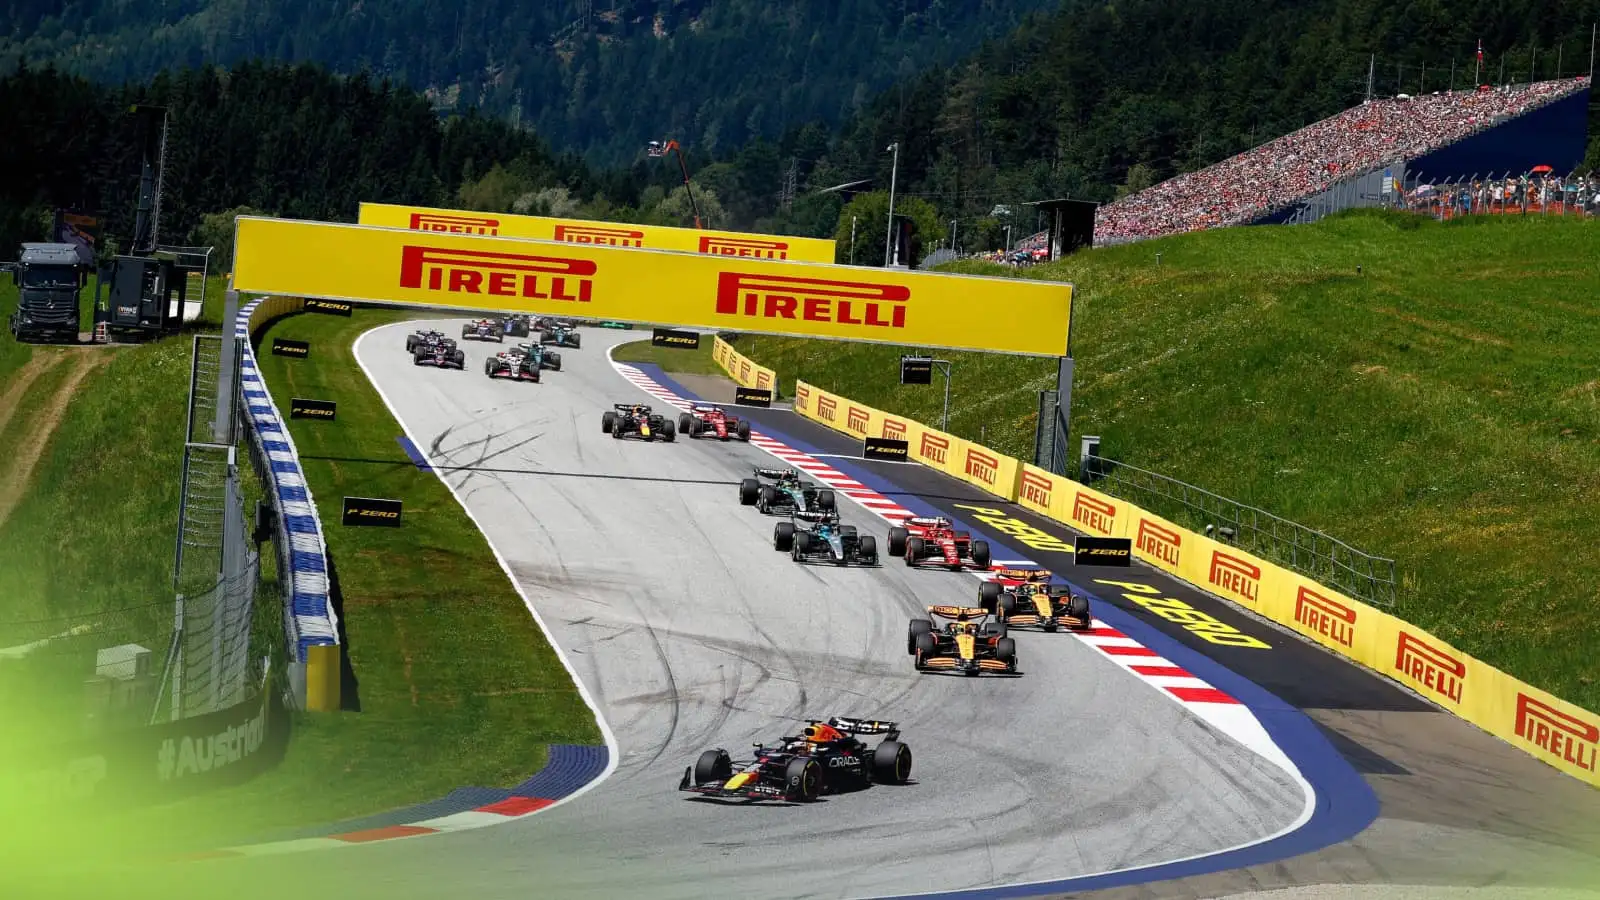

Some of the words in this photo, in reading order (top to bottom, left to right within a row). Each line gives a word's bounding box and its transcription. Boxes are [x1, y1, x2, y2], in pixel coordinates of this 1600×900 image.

[400, 245, 597, 302] PIRELLI
[317, 301, 350, 311] ZERO
[716, 271, 910, 328] PIRELLI
[664, 336, 697, 345] ZERO
[302, 408, 334, 416] ZERO
[875, 446, 906, 454] ZERO
[965, 448, 998, 485] PIRELLI
[1020, 470, 1052, 509] PIRELLI
[360, 509, 399, 518] ZERO
[1072, 491, 1116, 535] PIRELLI
[1135, 518, 1181, 566] PIRELLI
[1093, 579, 1162, 594] P
[1209, 550, 1261, 604] PIRELLI
[1121, 593, 1273, 649] ZERO
[1294, 586, 1356, 648] PIRELLI
[1395, 630, 1466, 704] PIRELLI
[1514, 692, 1600, 772] PIRELLI
